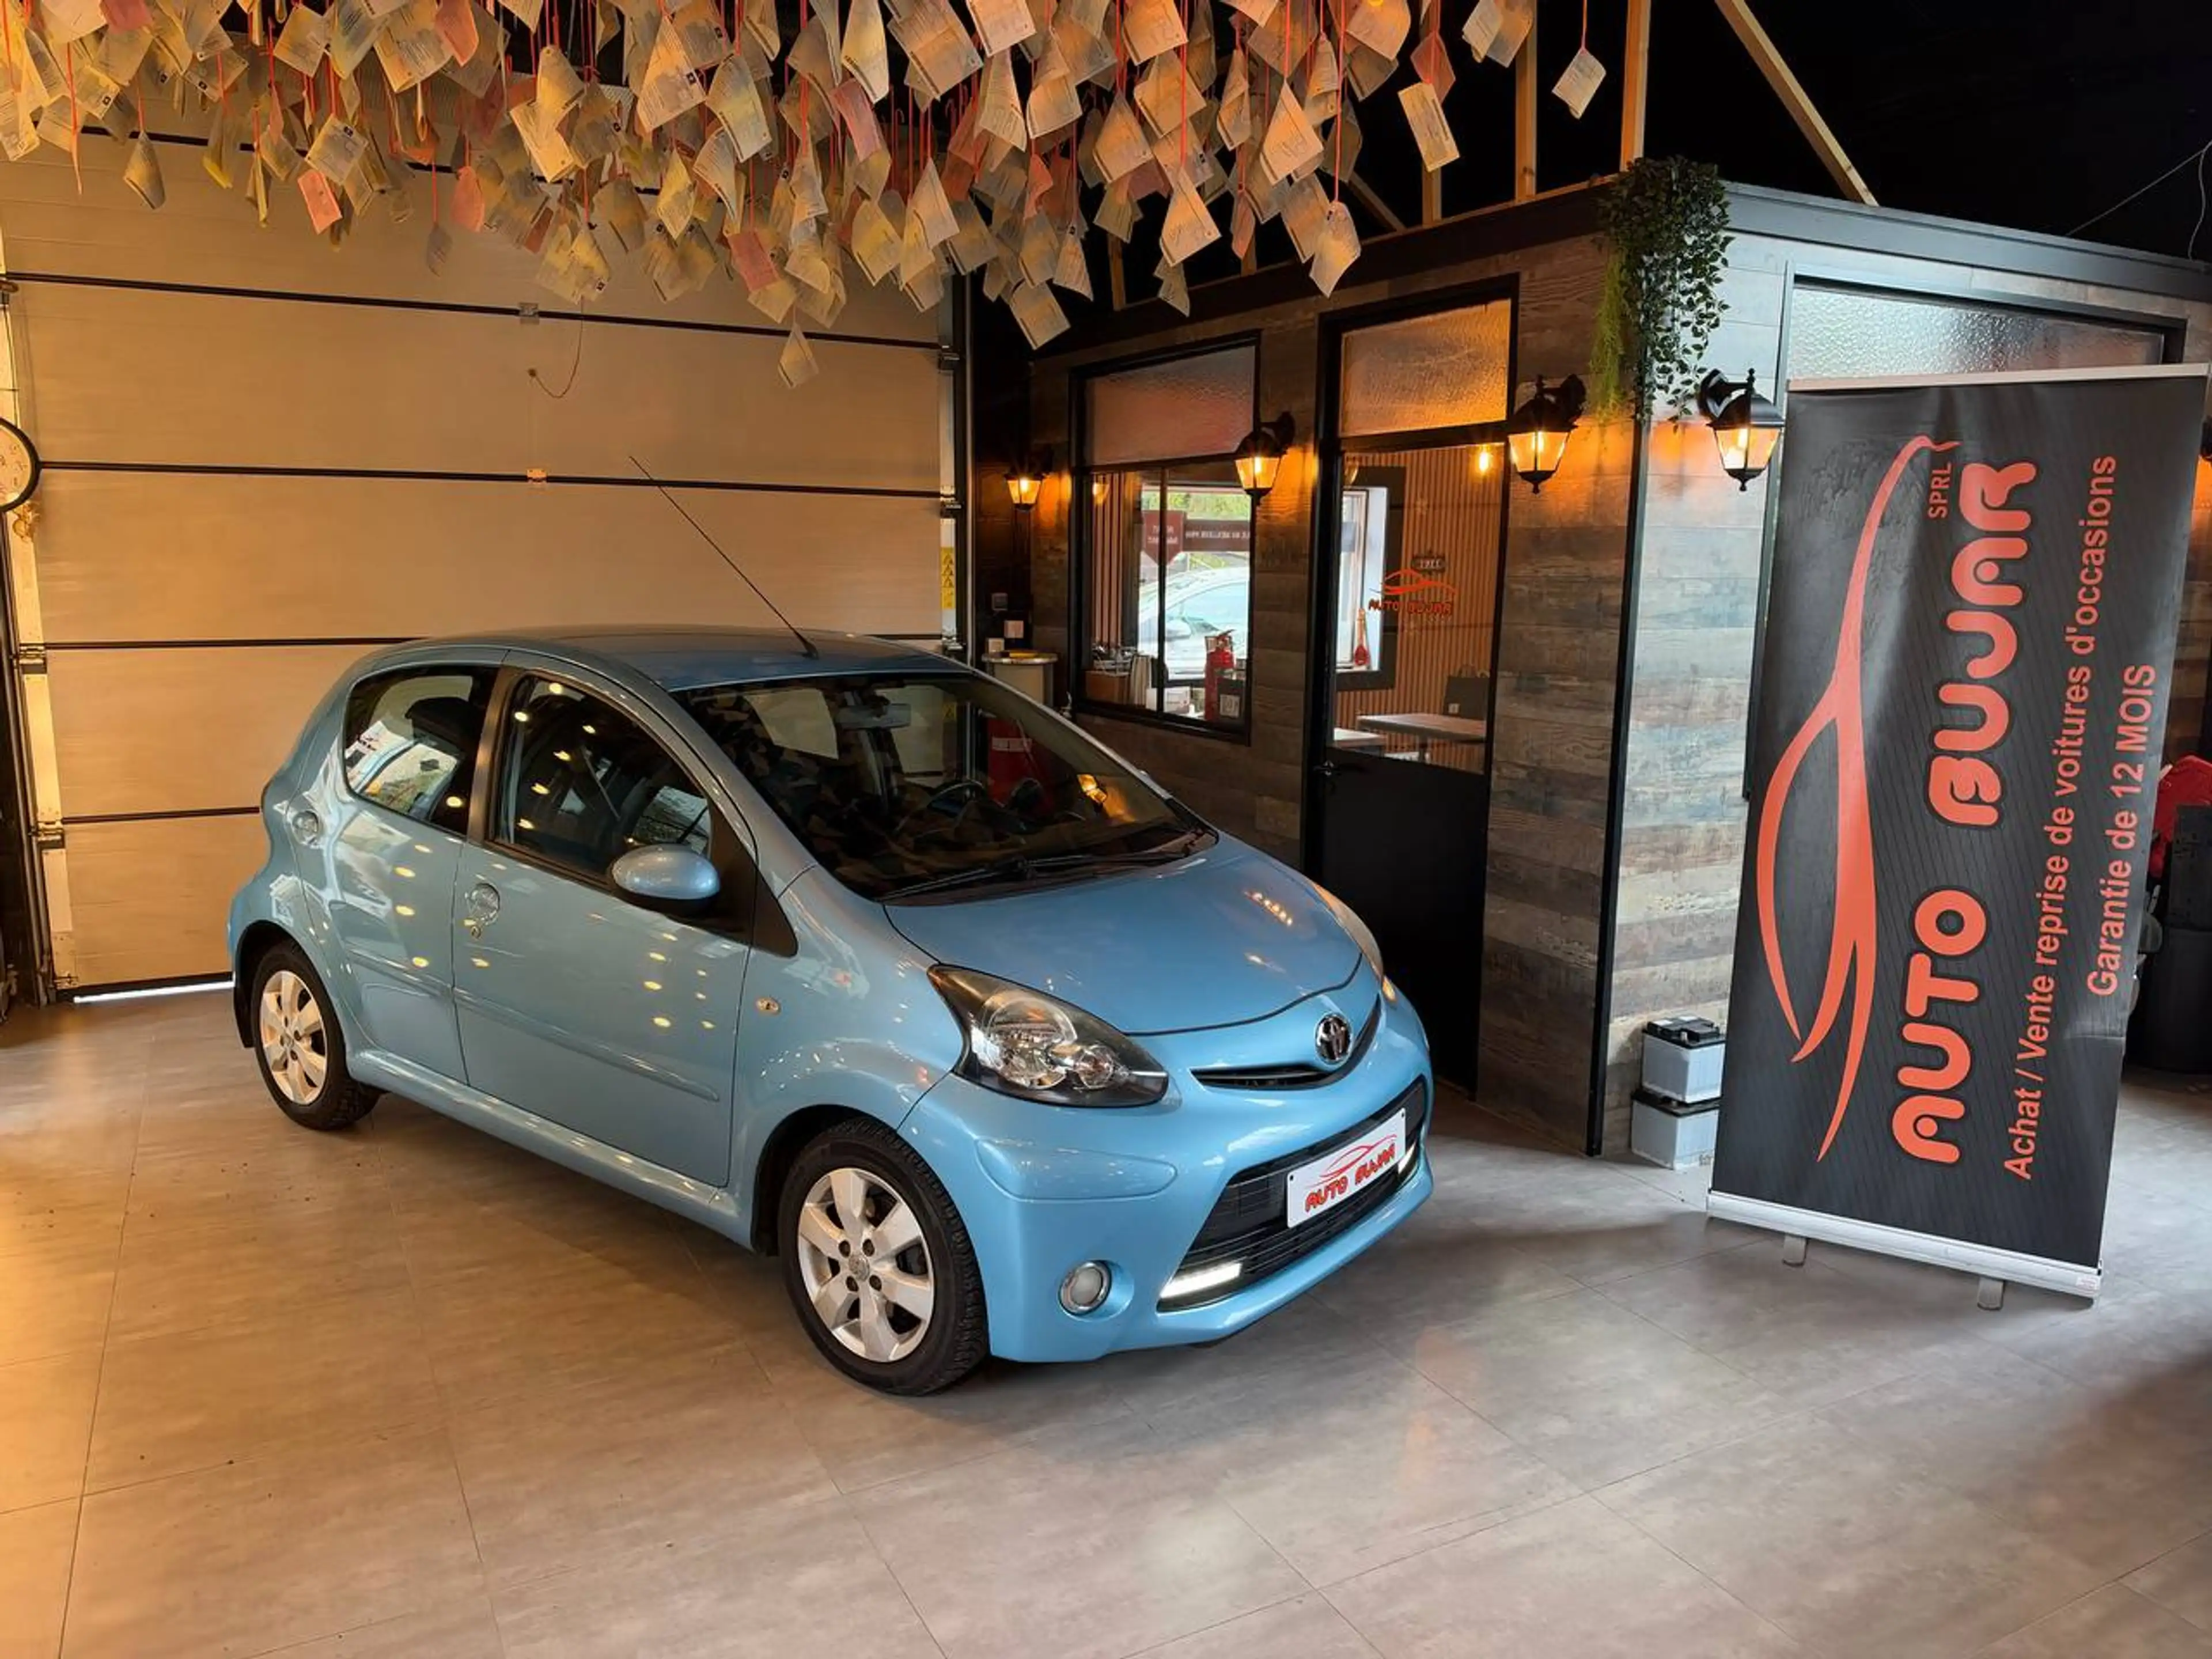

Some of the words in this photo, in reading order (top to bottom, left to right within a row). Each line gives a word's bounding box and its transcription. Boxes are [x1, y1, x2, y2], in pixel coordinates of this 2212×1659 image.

[1927, 463, 1952, 518] SPRL
[2065, 456, 2116, 655] d'occasions
[1929, 461, 2036, 825] BUJAR
[2052, 666, 2091, 796] voitures
[2116, 664, 2156, 752] MOIS
[2111, 763, 2144, 798] 12
[2044, 806, 2075, 845] de
[2105, 812, 2137, 850] de
[2036, 856, 2069, 966] reprise
[2086, 860, 2133, 995] Garantie
[1892, 889, 1986, 1164] AUTO
[2017, 975, 2055, 1059] Vente
[2015, 1067, 2043, 1084] /
[2003, 1088, 2041, 1179] Achat
[1305, 1175, 1349, 1213] AUTO
